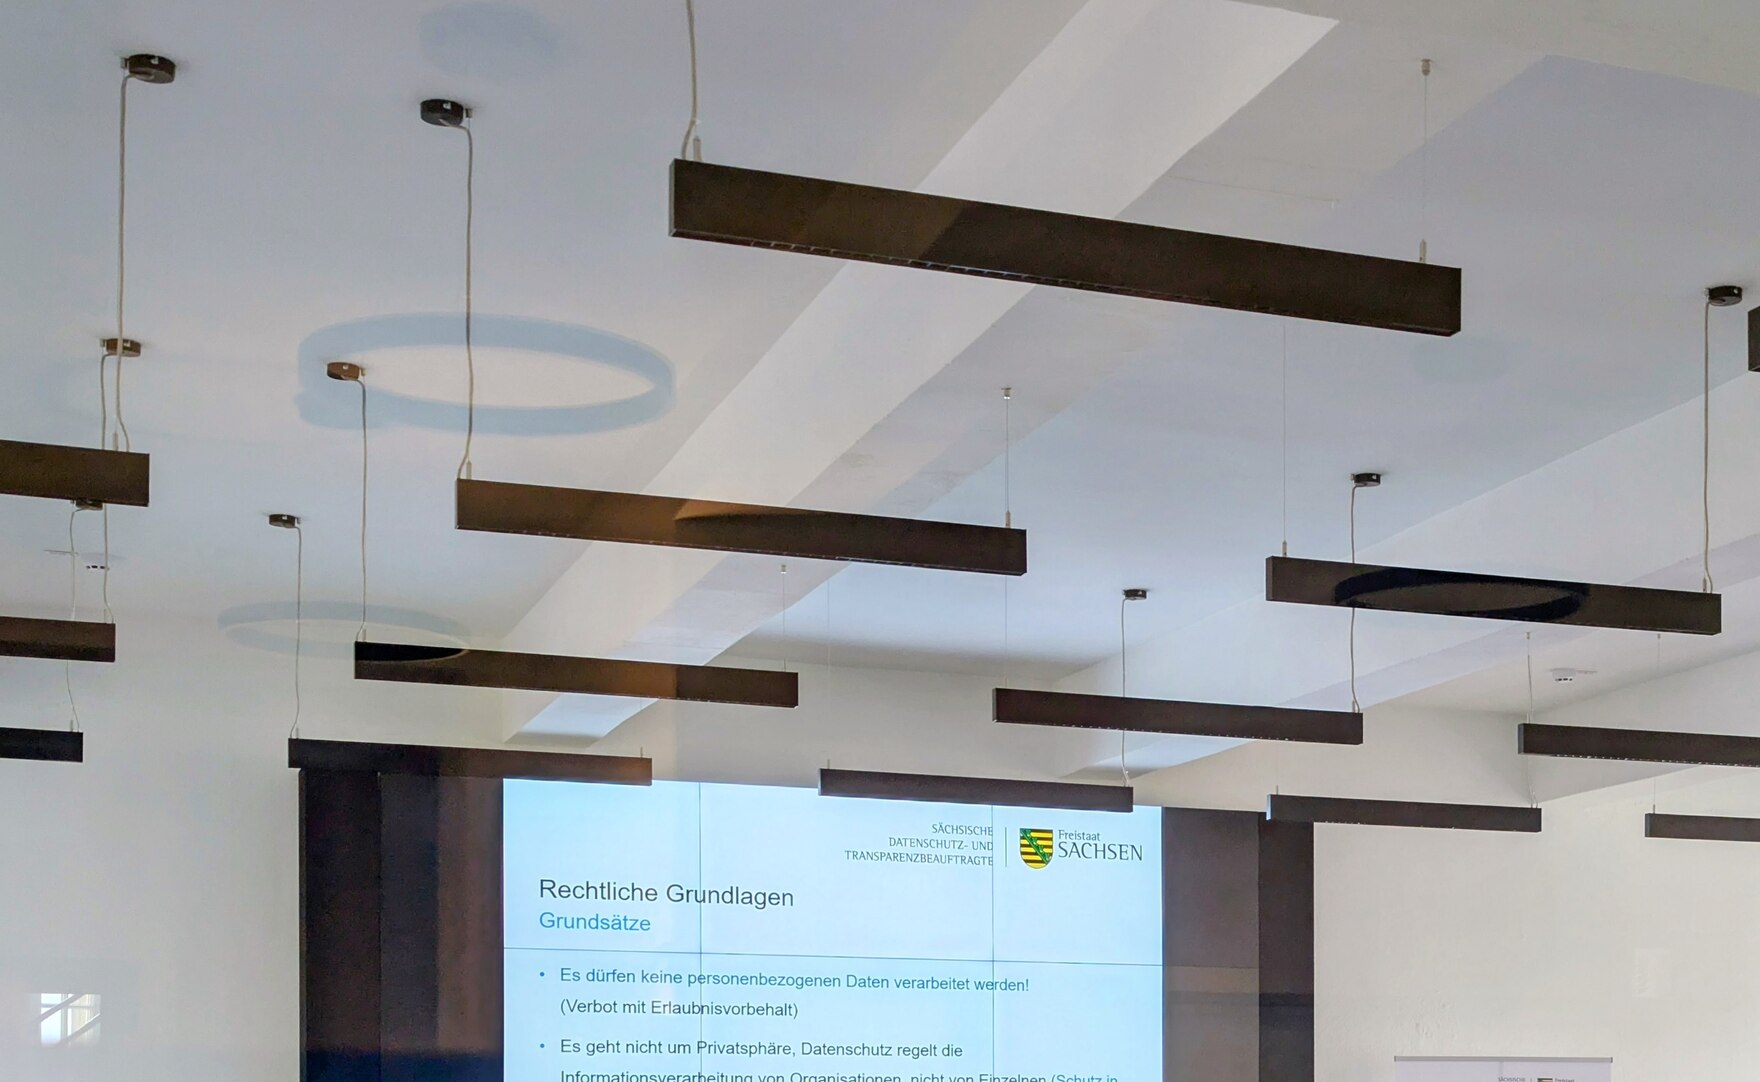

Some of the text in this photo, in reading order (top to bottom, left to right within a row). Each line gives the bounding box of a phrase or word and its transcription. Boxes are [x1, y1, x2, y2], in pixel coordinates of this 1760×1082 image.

[931, 823, 994, 836] SÄCHSISCHE
[1058, 830, 1101, 841] Freistaat
[888, 837, 994, 851] DATENSCHUTZ- UND
[1058, 842, 1144, 861] SACHSEN
[843, 850, 994, 866] TRANSPARENZBEAUFTRAGTE
[539, 879, 794, 909] Rechtliche Grundlagen
[539, 912, 651, 931] Grundsätze
[560, 968, 1029, 991] Es dürfen keine personenbezogenen Daten verarbeitet werden!
[560, 999, 799, 1019] (Verbot mit Erlaubnisvorbehalt)
[560, 1039, 963, 1059] Es geht nicht um Privatsphäre, Datenschutz regelt die
